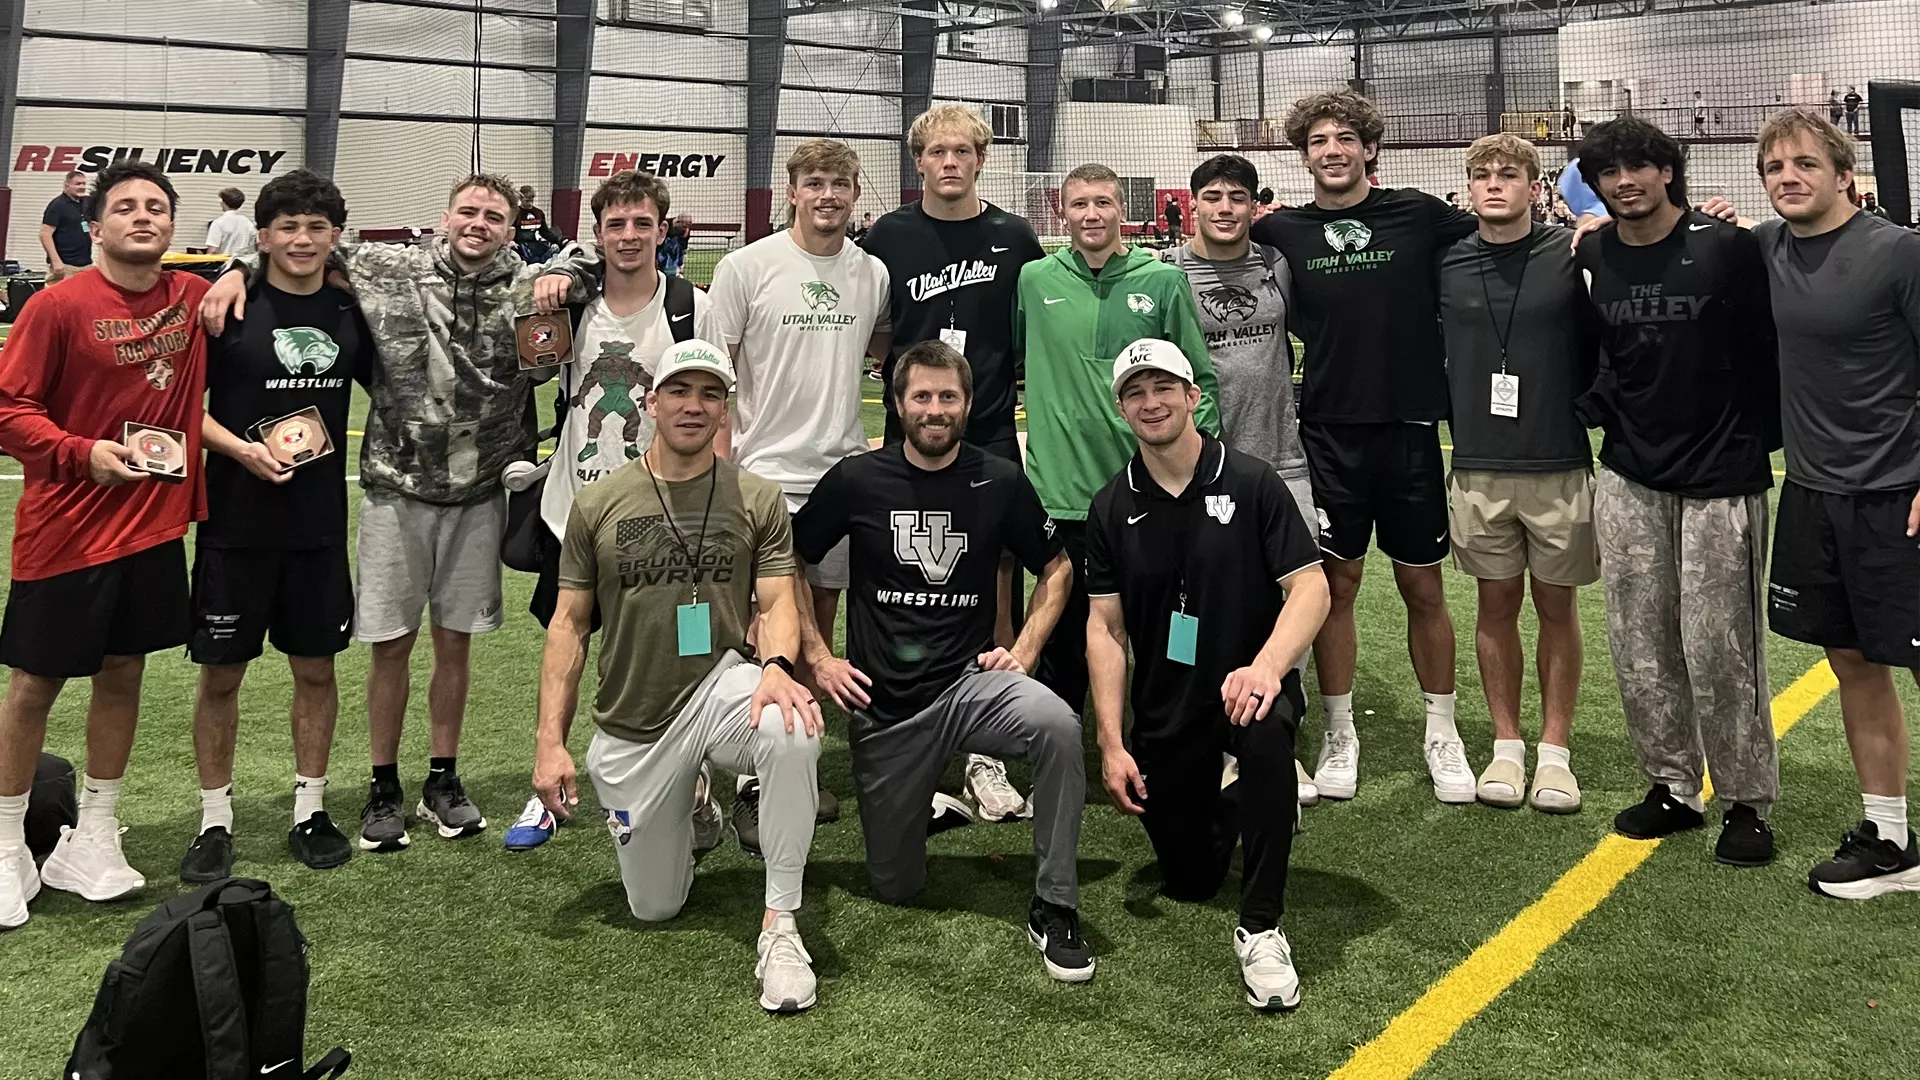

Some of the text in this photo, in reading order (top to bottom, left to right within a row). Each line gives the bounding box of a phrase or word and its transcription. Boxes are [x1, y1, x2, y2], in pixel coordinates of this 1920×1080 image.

[588, 152, 726, 178] ENERGY
[1306, 250, 1396, 271] UTAH VALLEY
[1325, 263, 1378, 275] WRESTLING
[945, 260, 997, 290] Valley
[1630, 283, 1662, 298] THE
[782, 314, 857, 325] UTAH VALLEY
[1599, 295, 1712, 325] VALLEY
[93, 319, 136, 342] STAY
[1203, 323, 1277, 343] TAH VALLEY
[114, 328, 190, 366] FOR MORE
[1213, 337, 1263, 349] WRESTLING
[265, 378, 344, 390] WRESTLING
[618, 555, 734, 573] BRUNSON
[620, 568, 734, 588] UVRTC
[876, 589, 979, 607] WRESTLING
